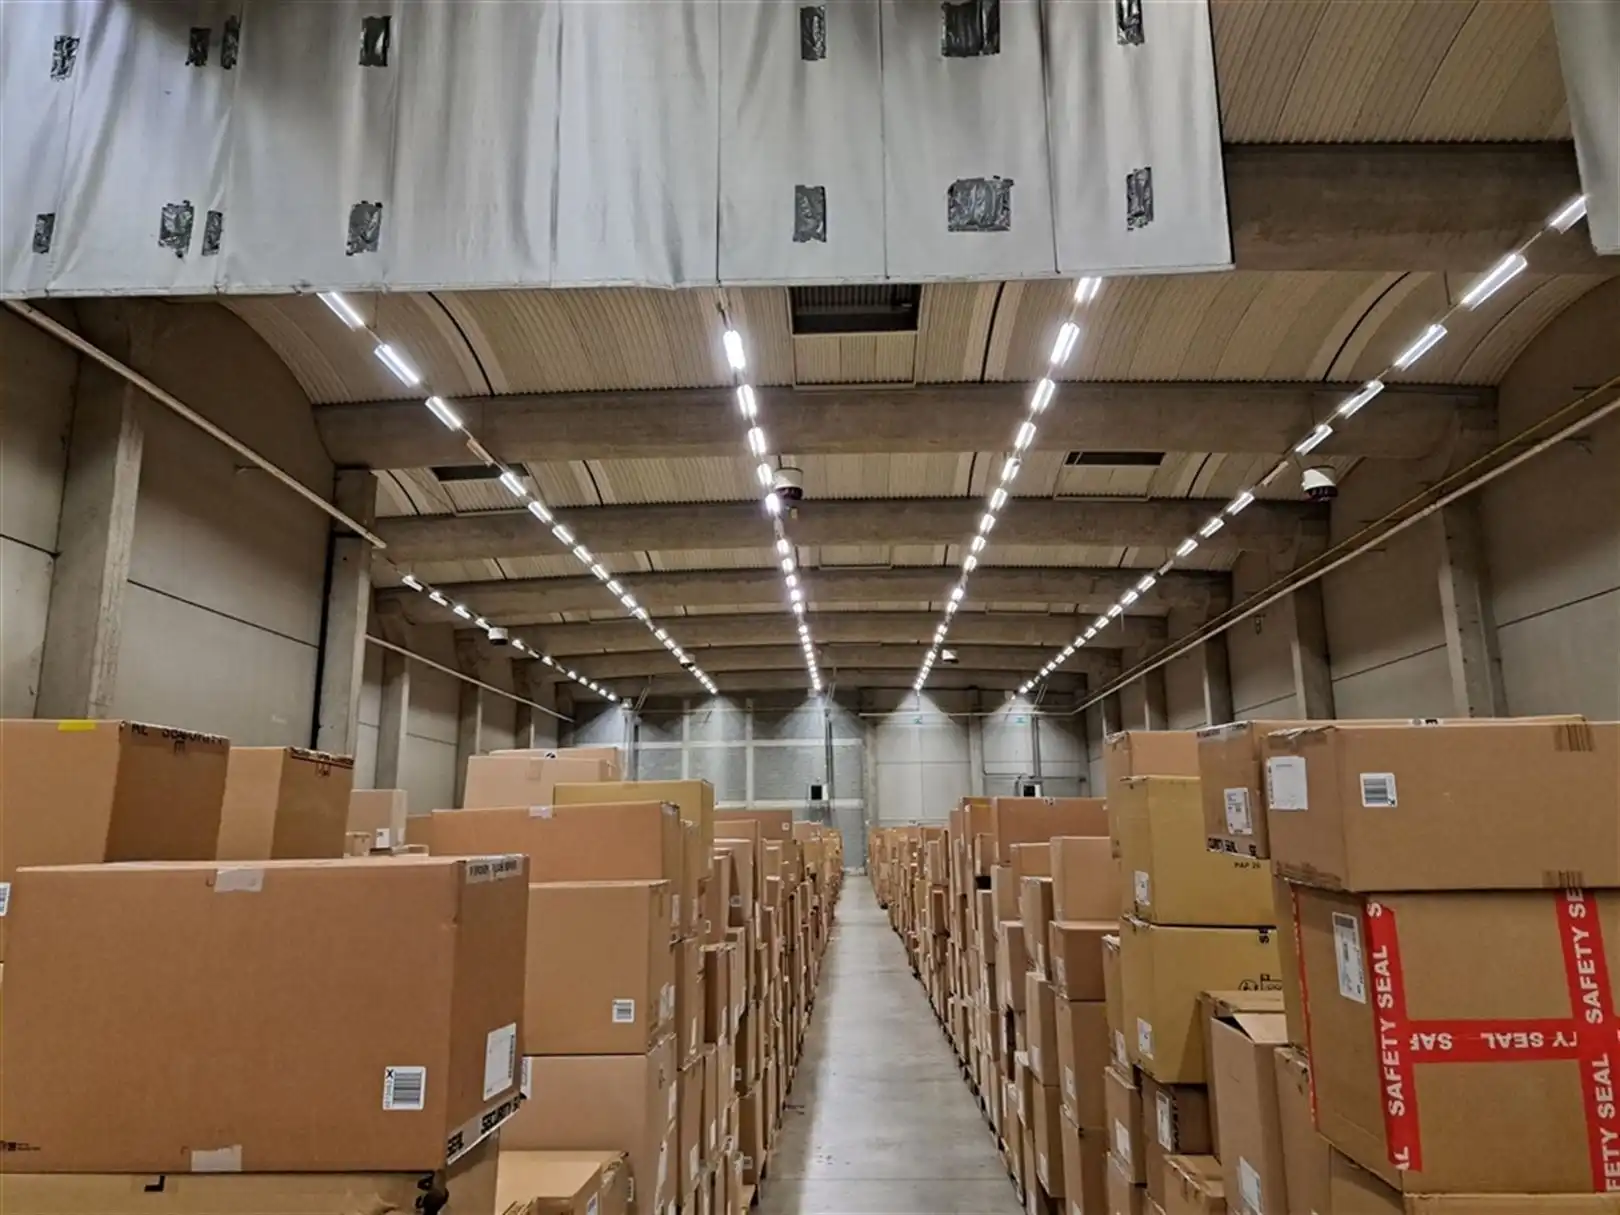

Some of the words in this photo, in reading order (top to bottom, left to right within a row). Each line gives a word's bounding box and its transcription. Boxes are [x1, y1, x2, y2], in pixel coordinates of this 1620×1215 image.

[1373, 945, 1394, 1008] SEAL
[1571, 926, 1604, 1025] SAFETY
[1379, 1017, 1405, 1117] SAFETY
[1481, 1032, 1545, 1049] SEAL
[1592, 1053, 1616, 1119] SEAL
